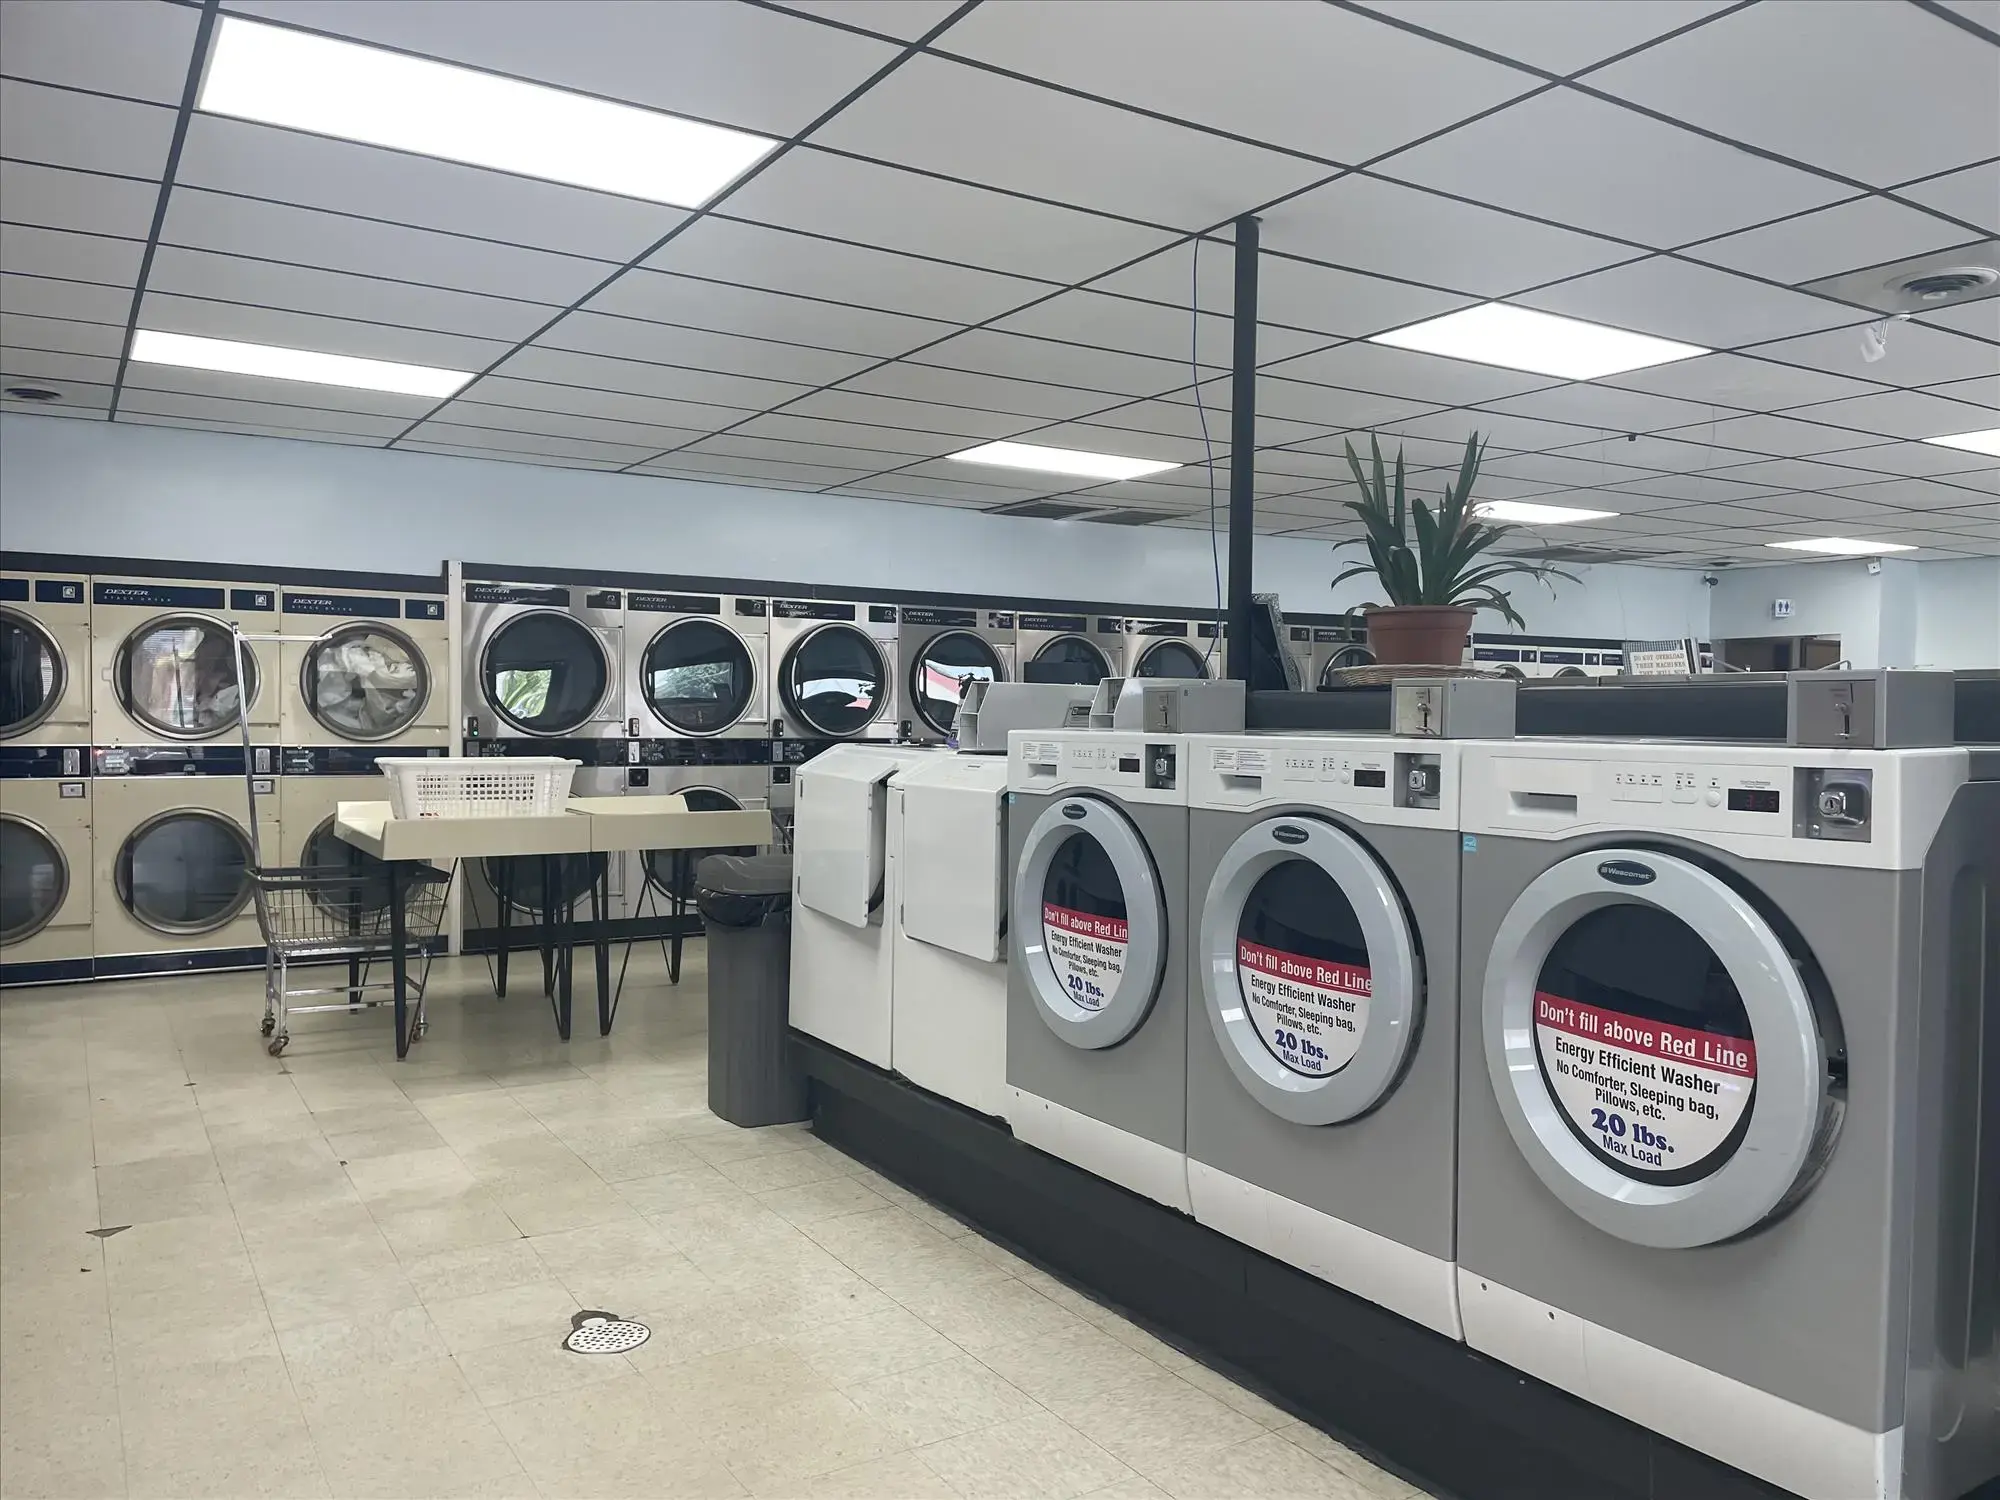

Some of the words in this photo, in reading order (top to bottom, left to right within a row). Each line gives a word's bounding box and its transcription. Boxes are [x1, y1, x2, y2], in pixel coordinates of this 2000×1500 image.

[1608, 868, 1649, 879] Wascomat
[1045, 907, 1059, 923] Don't
[1071, 917, 1091, 931] above
[1095, 922, 1110, 935] Red
[1114, 925, 1128, 938] Lin
[1052, 930, 1067, 946] Energy
[1069, 936, 1094, 953] Efficient
[1096, 944, 1122, 957] Washer
[1083, 955, 1106, 970] Sleeping
[1089, 967, 1099, 977] etc.
[1242, 946, 1262, 966] Don't
[1266, 954, 1277, 970] fill
[1281, 960, 1312, 979] above
[1317, 967, 1339, 984] Red
[1345, 972, 1372, 990] Line
[1068, 974, 1083, 991] 20
[1085, 980, 1104, 997] lbs.
[1073, 991, 1084, 1002] Max
[1086, 995, 1099, 1007] Load
[1252, 975, 1275, 996] Energy
[1278, 983, 1314, 1004] Efficient
[1318, 993, 1355, 1012] Washer
[1252, 992, 1260, 1004] No
[1262, 996, 1297, 1018] Comforter,
[1298, 1007, 1333, 1028] Sleeping
[1336, 1016, 1355, 1032] bag,
[1277, 1014, 1305, 1032] Pillows,
[1307, 1023, 1322, 1035] etc.
[1275, 1029, 1297, 1050] 20
[1301, 1039, 1328, 1060] lbs.
[1540, 1001, 1574, 1026] Don't
[1580, 1013, 1598, 1033] fill
[1604, 1021, 1653, 1047] above
[1661, 1032, 1695, 1057] Red
[1705, 1041, 1748, 1068] Line
[1283, 1050, 1299, 1064] Max
[1301, 1056, 1321, 1071] Load
[1556, 1037, 1594, 1064] Energy
[1599, 1050, 1655, 1079] Efficient
[1662, 1066, 1720, 1094] Washer
[1557, 1060, 1569, 1075] No
[1572, 1064, 1627, 1095] Comforter,
[1630, 1082, 1684, 1111] Sleeping
[1689, 1095, 1719, 1120] bag,
[1596, 1088, 1639, 1115] Pillows,
[1643, 1105, 1666, 1120] etc.
[1591, 1108, 1626, 1137] 20
[1633, 1124, 1674, 1153] lbs.
[1603, 1135, 1628, 1155] Max
[1631, 1144, 1661, 1166] Load
